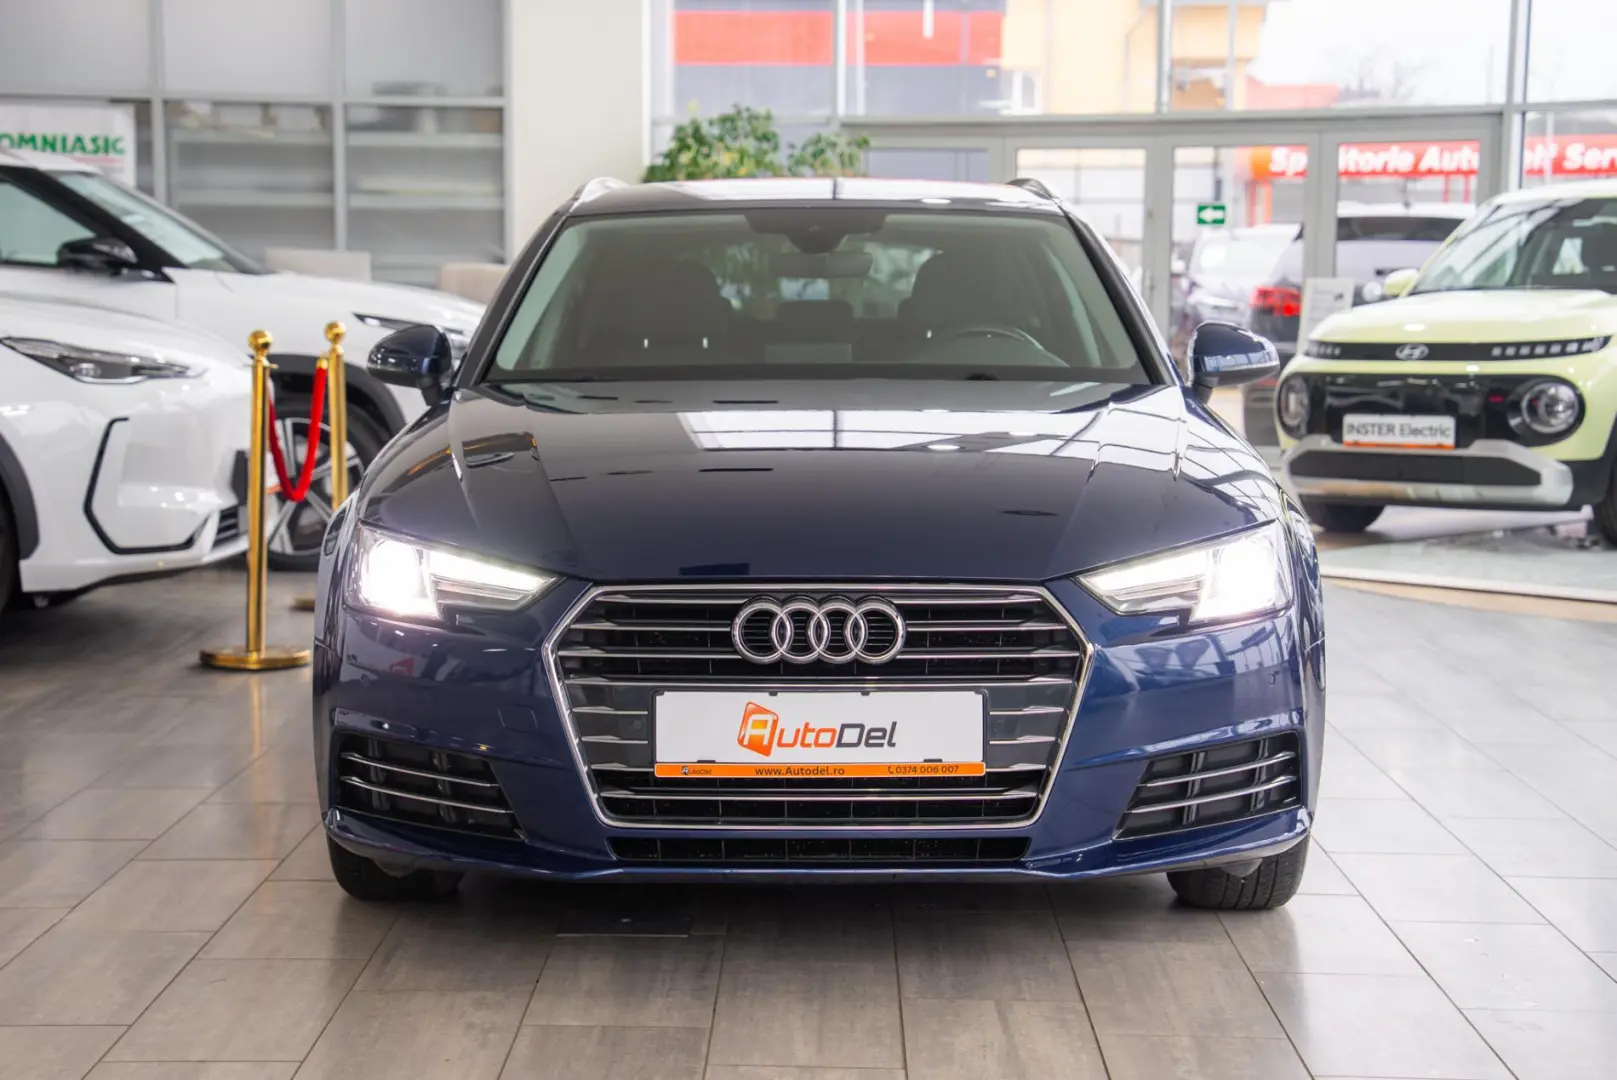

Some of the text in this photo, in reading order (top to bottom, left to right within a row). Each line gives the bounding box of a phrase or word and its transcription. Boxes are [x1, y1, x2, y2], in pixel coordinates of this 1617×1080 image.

[1346, 422, 1452, 438] INSTER Electric
[737, 701, 898, 757] AutoDel
[755, 766, 846, 776] www.Autodel.ro
[895, 764, 960, 774] 0374 006 007
